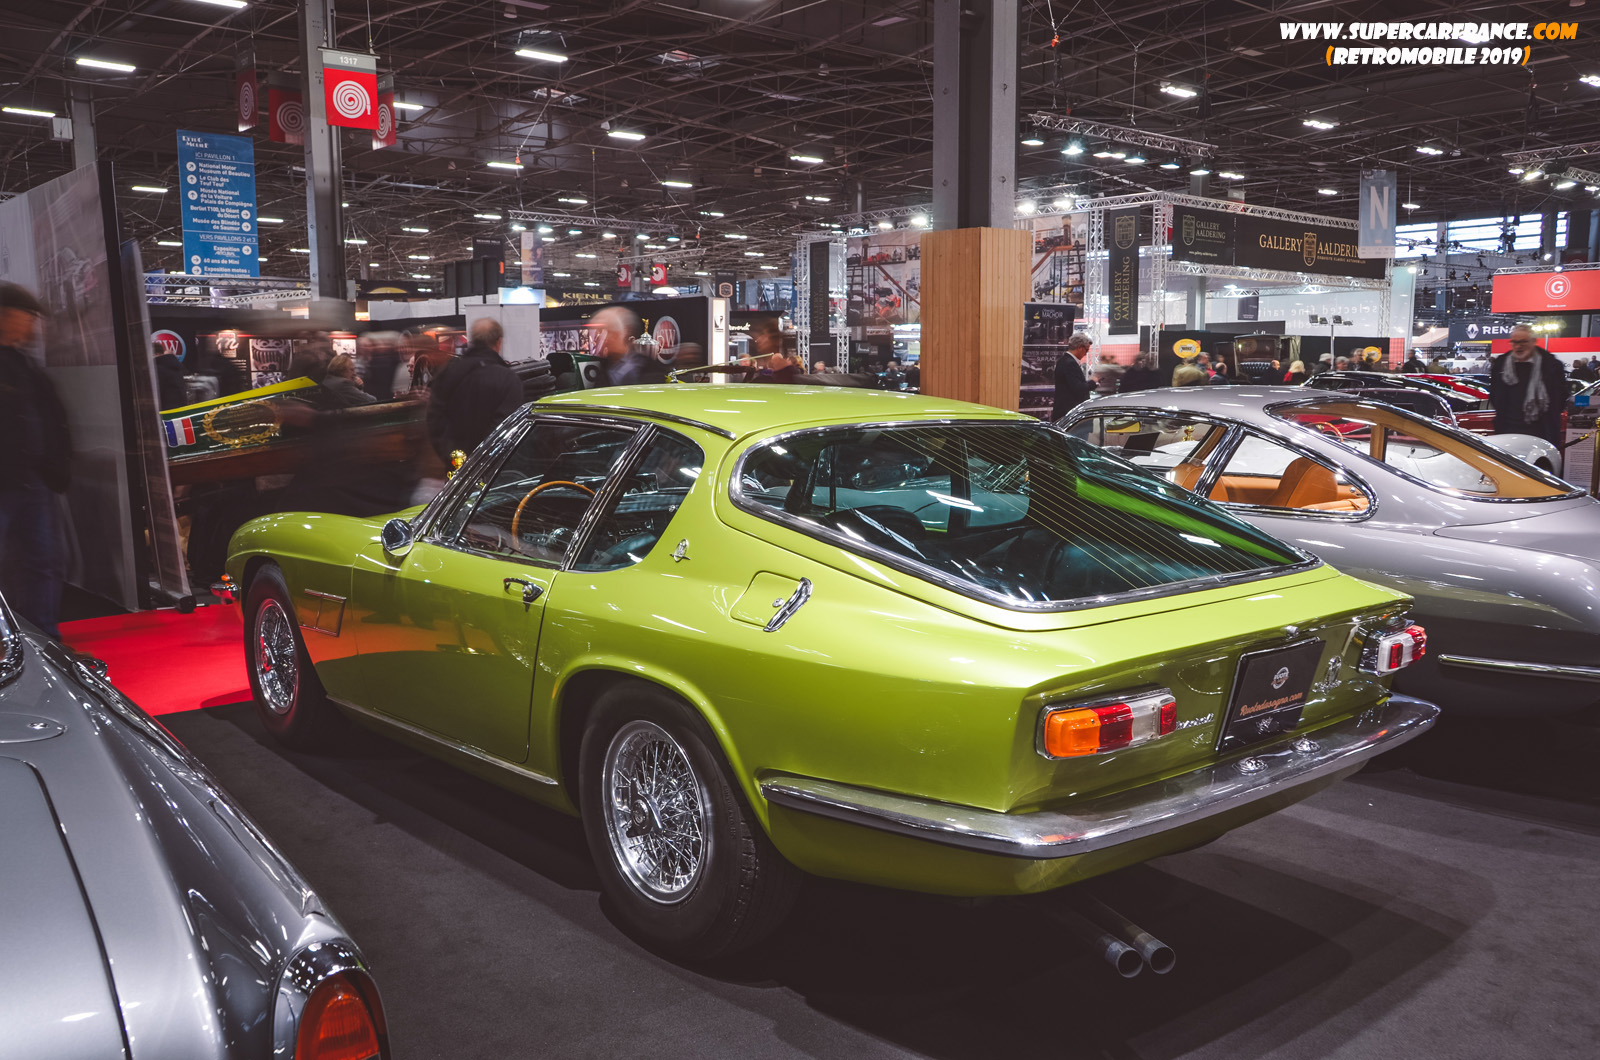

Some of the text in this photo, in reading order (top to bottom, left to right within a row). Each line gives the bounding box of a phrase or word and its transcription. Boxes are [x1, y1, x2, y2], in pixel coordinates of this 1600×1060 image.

[339, 56, 358, 65] 1317
[199, 167, 221, 175] Museum
[224, 200, 253, 208] Compiègne
[1370, 186, 1389, 230] N
[1196, 220, 1220, 230] GALLERY
[214, 234, 242, 242] PAVILLONS
[1195, 229, 1226, 239] AALDERING
[213, 245, 240, 253] Exposition
[1259, 234, 1303, 252] GALLERY
[1317, 242, 1359, 258] AALDERIN
[1121, 256, 1131, 321] AALDERING
[1551, 281, 1564, 294] G
[562, 292, 613, 300] KIENLE
[1113, 271, 1122, 321] GALLERY
